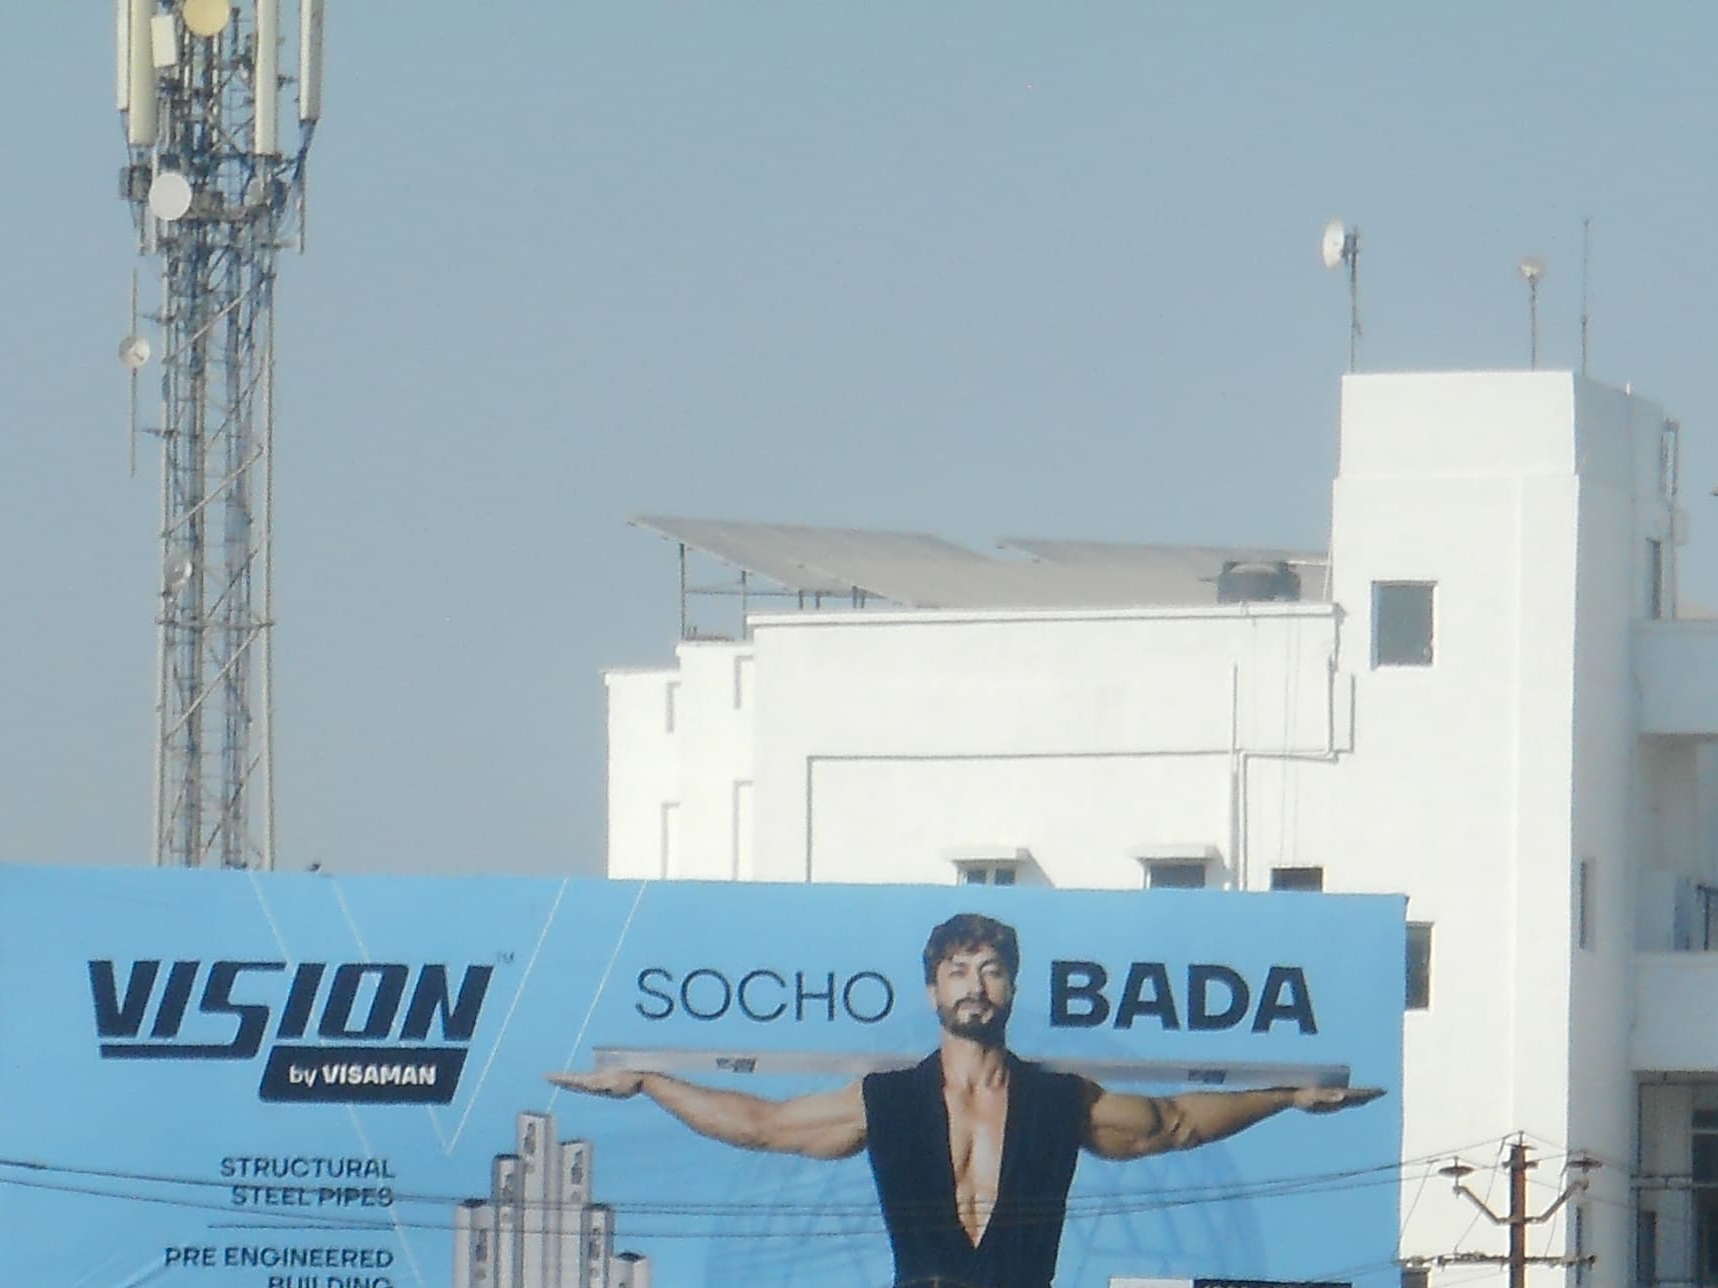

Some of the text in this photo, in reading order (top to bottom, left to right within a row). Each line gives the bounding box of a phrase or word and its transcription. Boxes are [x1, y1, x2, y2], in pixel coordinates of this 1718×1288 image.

[636, 967, 894, 1025] SOCHO
[1049, 960, 1318, 1036] BADA
[88, 960, 494, 1060] VISION
[290, 1065, 436, 1086] by VISAMAN
[221, 1156, 395, 1179] STRUCTURAL
[232, 1184, 394, 1208] STEEL PIPES
[164, 1246, 395, 1269] PRE ENGINEERED
